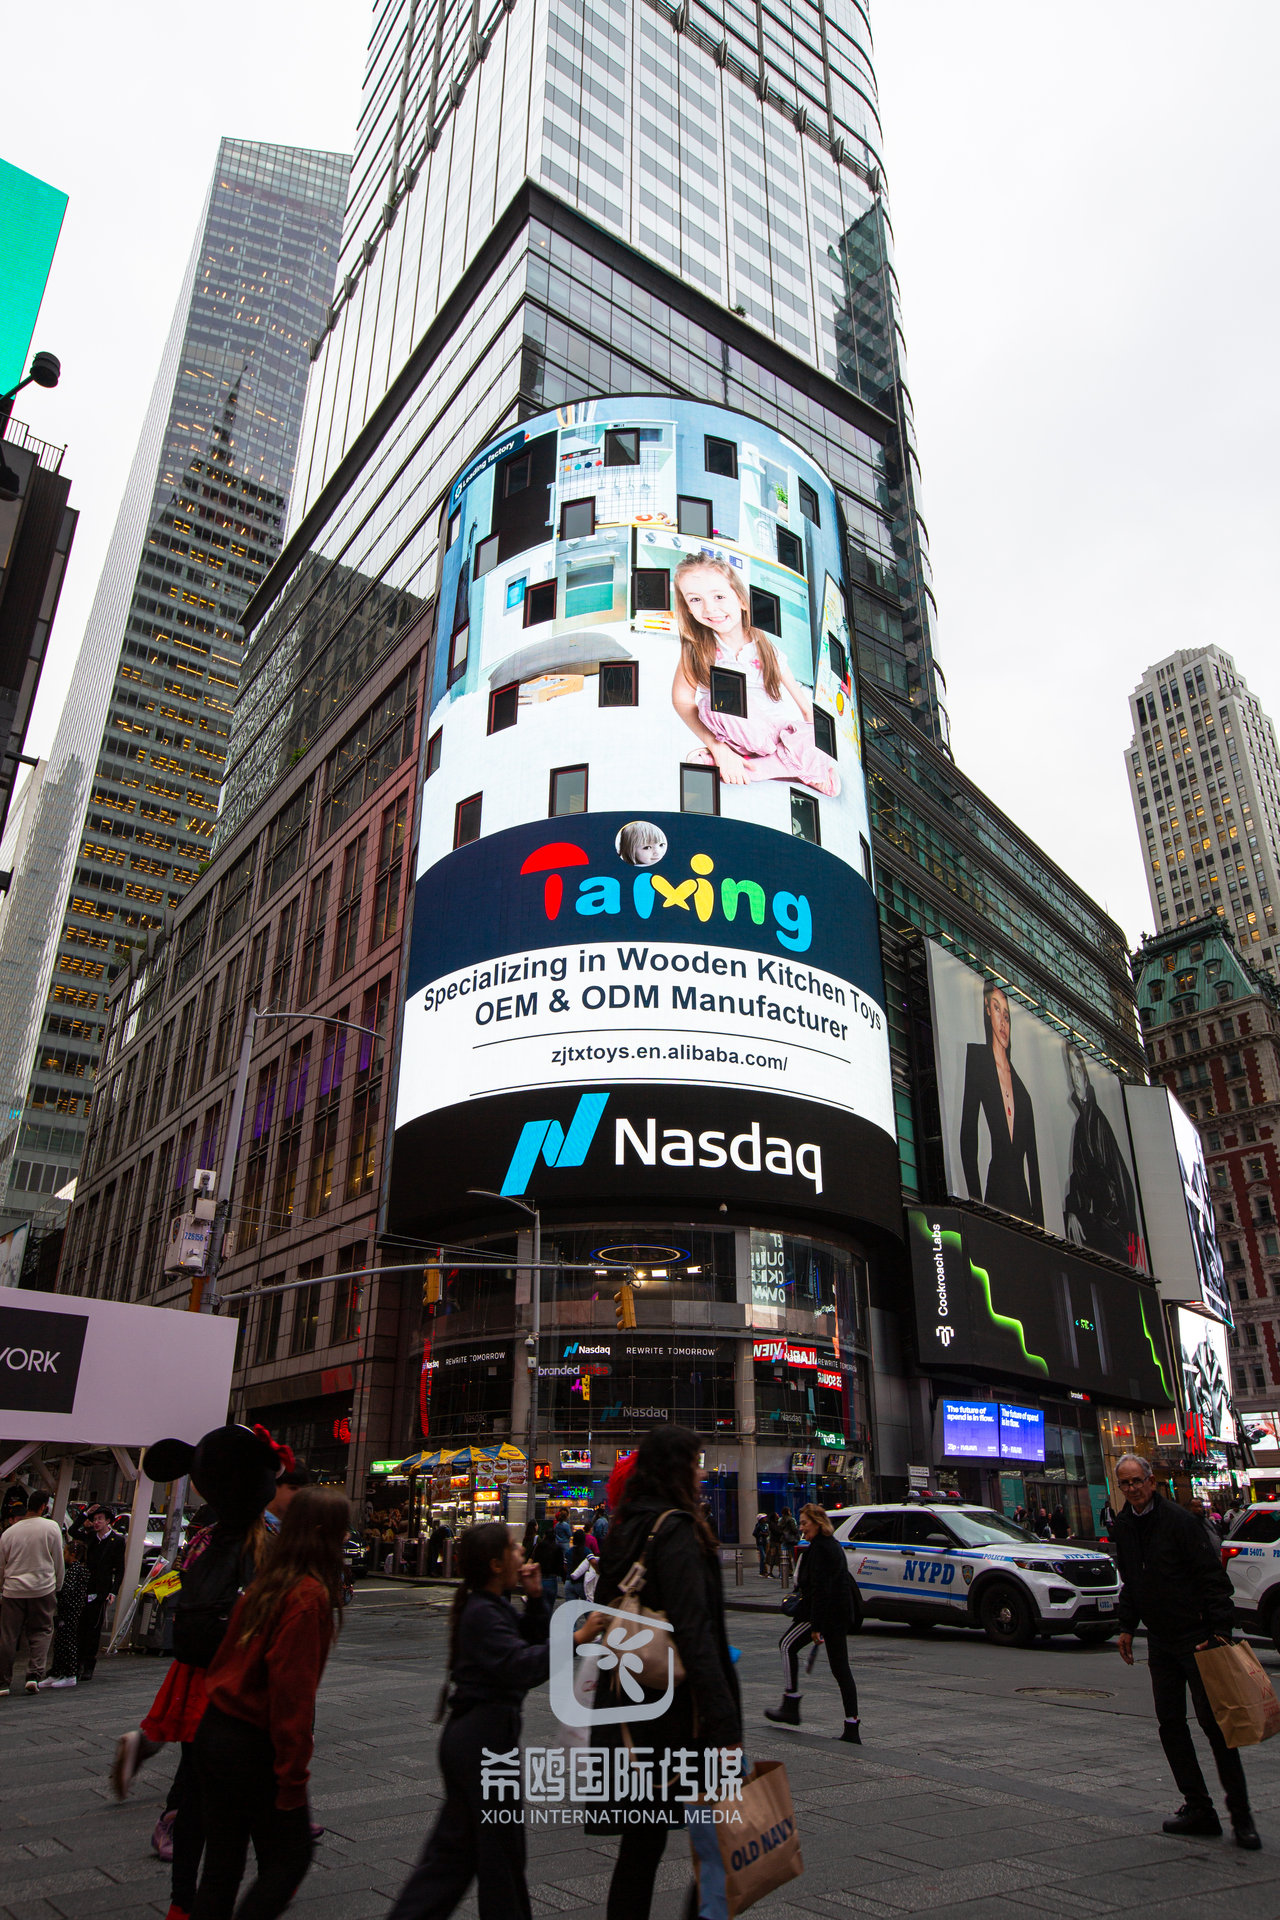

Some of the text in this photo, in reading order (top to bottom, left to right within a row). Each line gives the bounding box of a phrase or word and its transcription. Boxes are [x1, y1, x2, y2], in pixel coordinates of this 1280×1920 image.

[462, 440, 515, 488] Leading factory
[424, 947, 882, 1031] Specializing in Wooden Kitchen Toys
[475, 984, 848, 1041] OEM & ODM Manufacturer
[551, 1044, 788, 1071] zjtxtoys.en.alibaba.com/
[615, 1118, 823, 1195] Nasdaq
[931, 1223, 949, 1317] Cockroach Labs
[578, 1345, 716, 1356] Nasdaq REWRITE TOMORROW
[445, 1355, 468, 1366] REWRITE
[817, 1357, 839, 1368] REWRITE
[623, 1406, 669, 1420] Nasdaq
[946, 1405, 987, 1415] The future of
[946, 1413, 966, 1422] spend
[966, 1413, 972, 1421] is
[1001, 1408, 1009, 1417] The
[1009, 1409, 1023, 1419] future
[1026, 1413, 1039, 1423] spend
[781, 1412, 802, 1424] Nasdaq
[983, 1553, 1005, 1561] POLICE
[902, 1559, 955, 1585] NYPD
[731, 1815, 794, 1871] OLD NAVY
